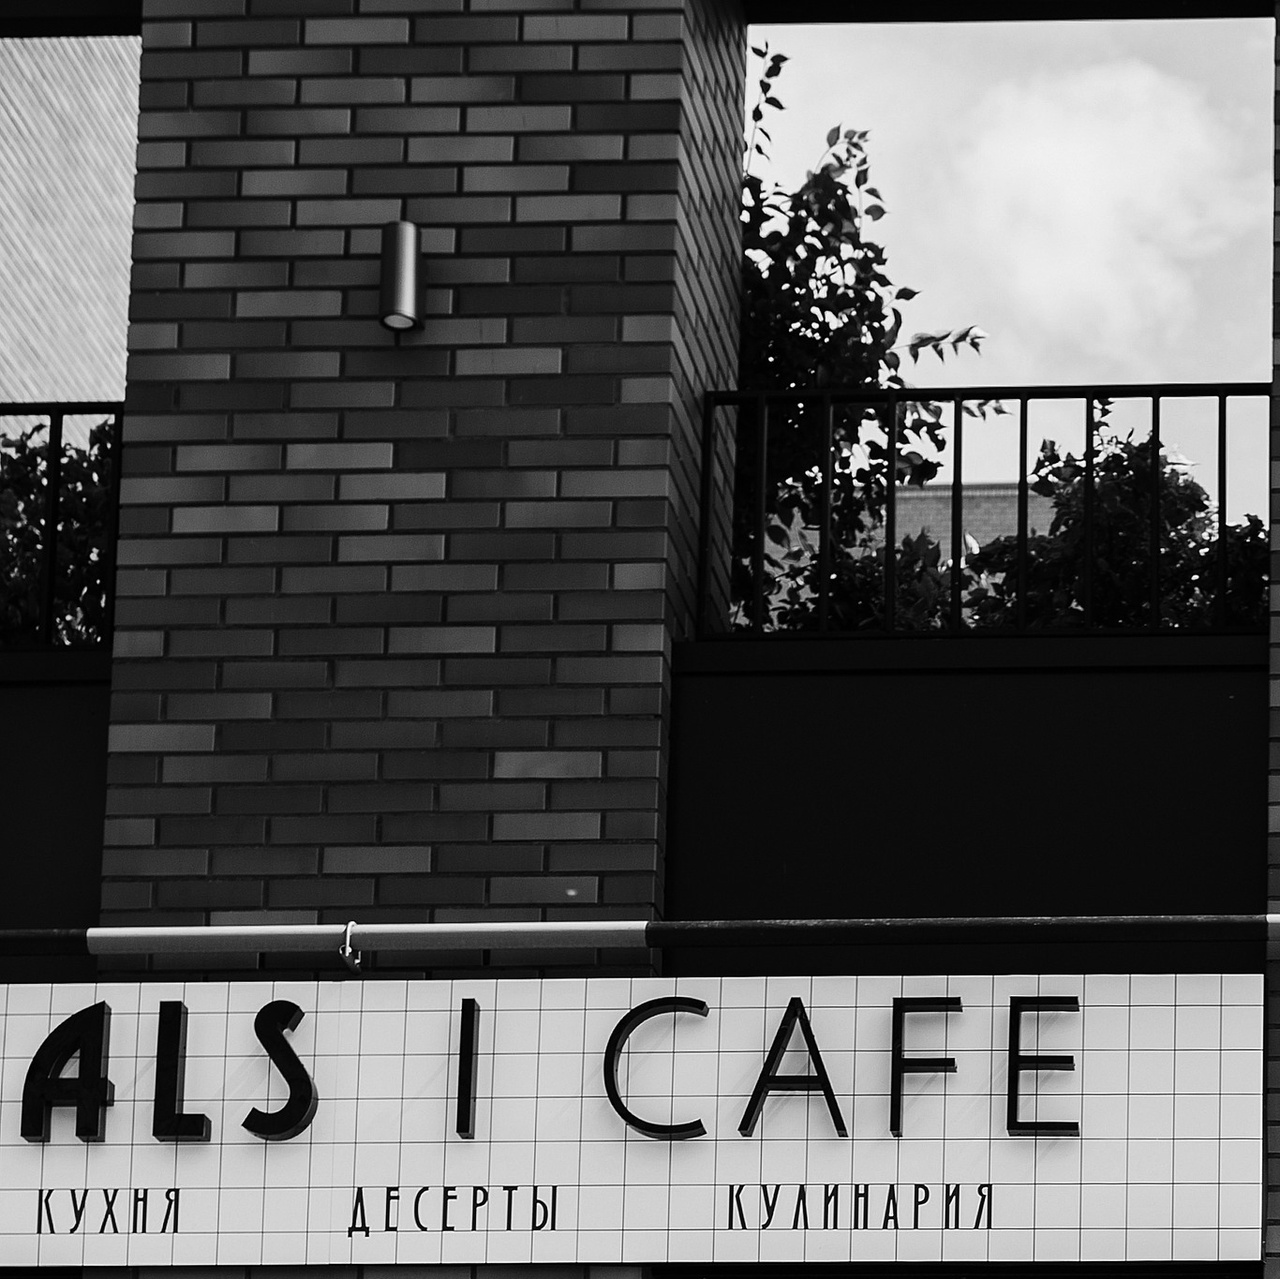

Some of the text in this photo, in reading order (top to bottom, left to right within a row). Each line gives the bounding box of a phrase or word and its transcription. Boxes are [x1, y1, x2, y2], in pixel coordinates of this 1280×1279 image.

[604, 996, 1080, 1141] CAFE
[36, 1184, 993, 1238] КУХНЯ ДЕСЕРТЫ КУЛИНАРИЯ
